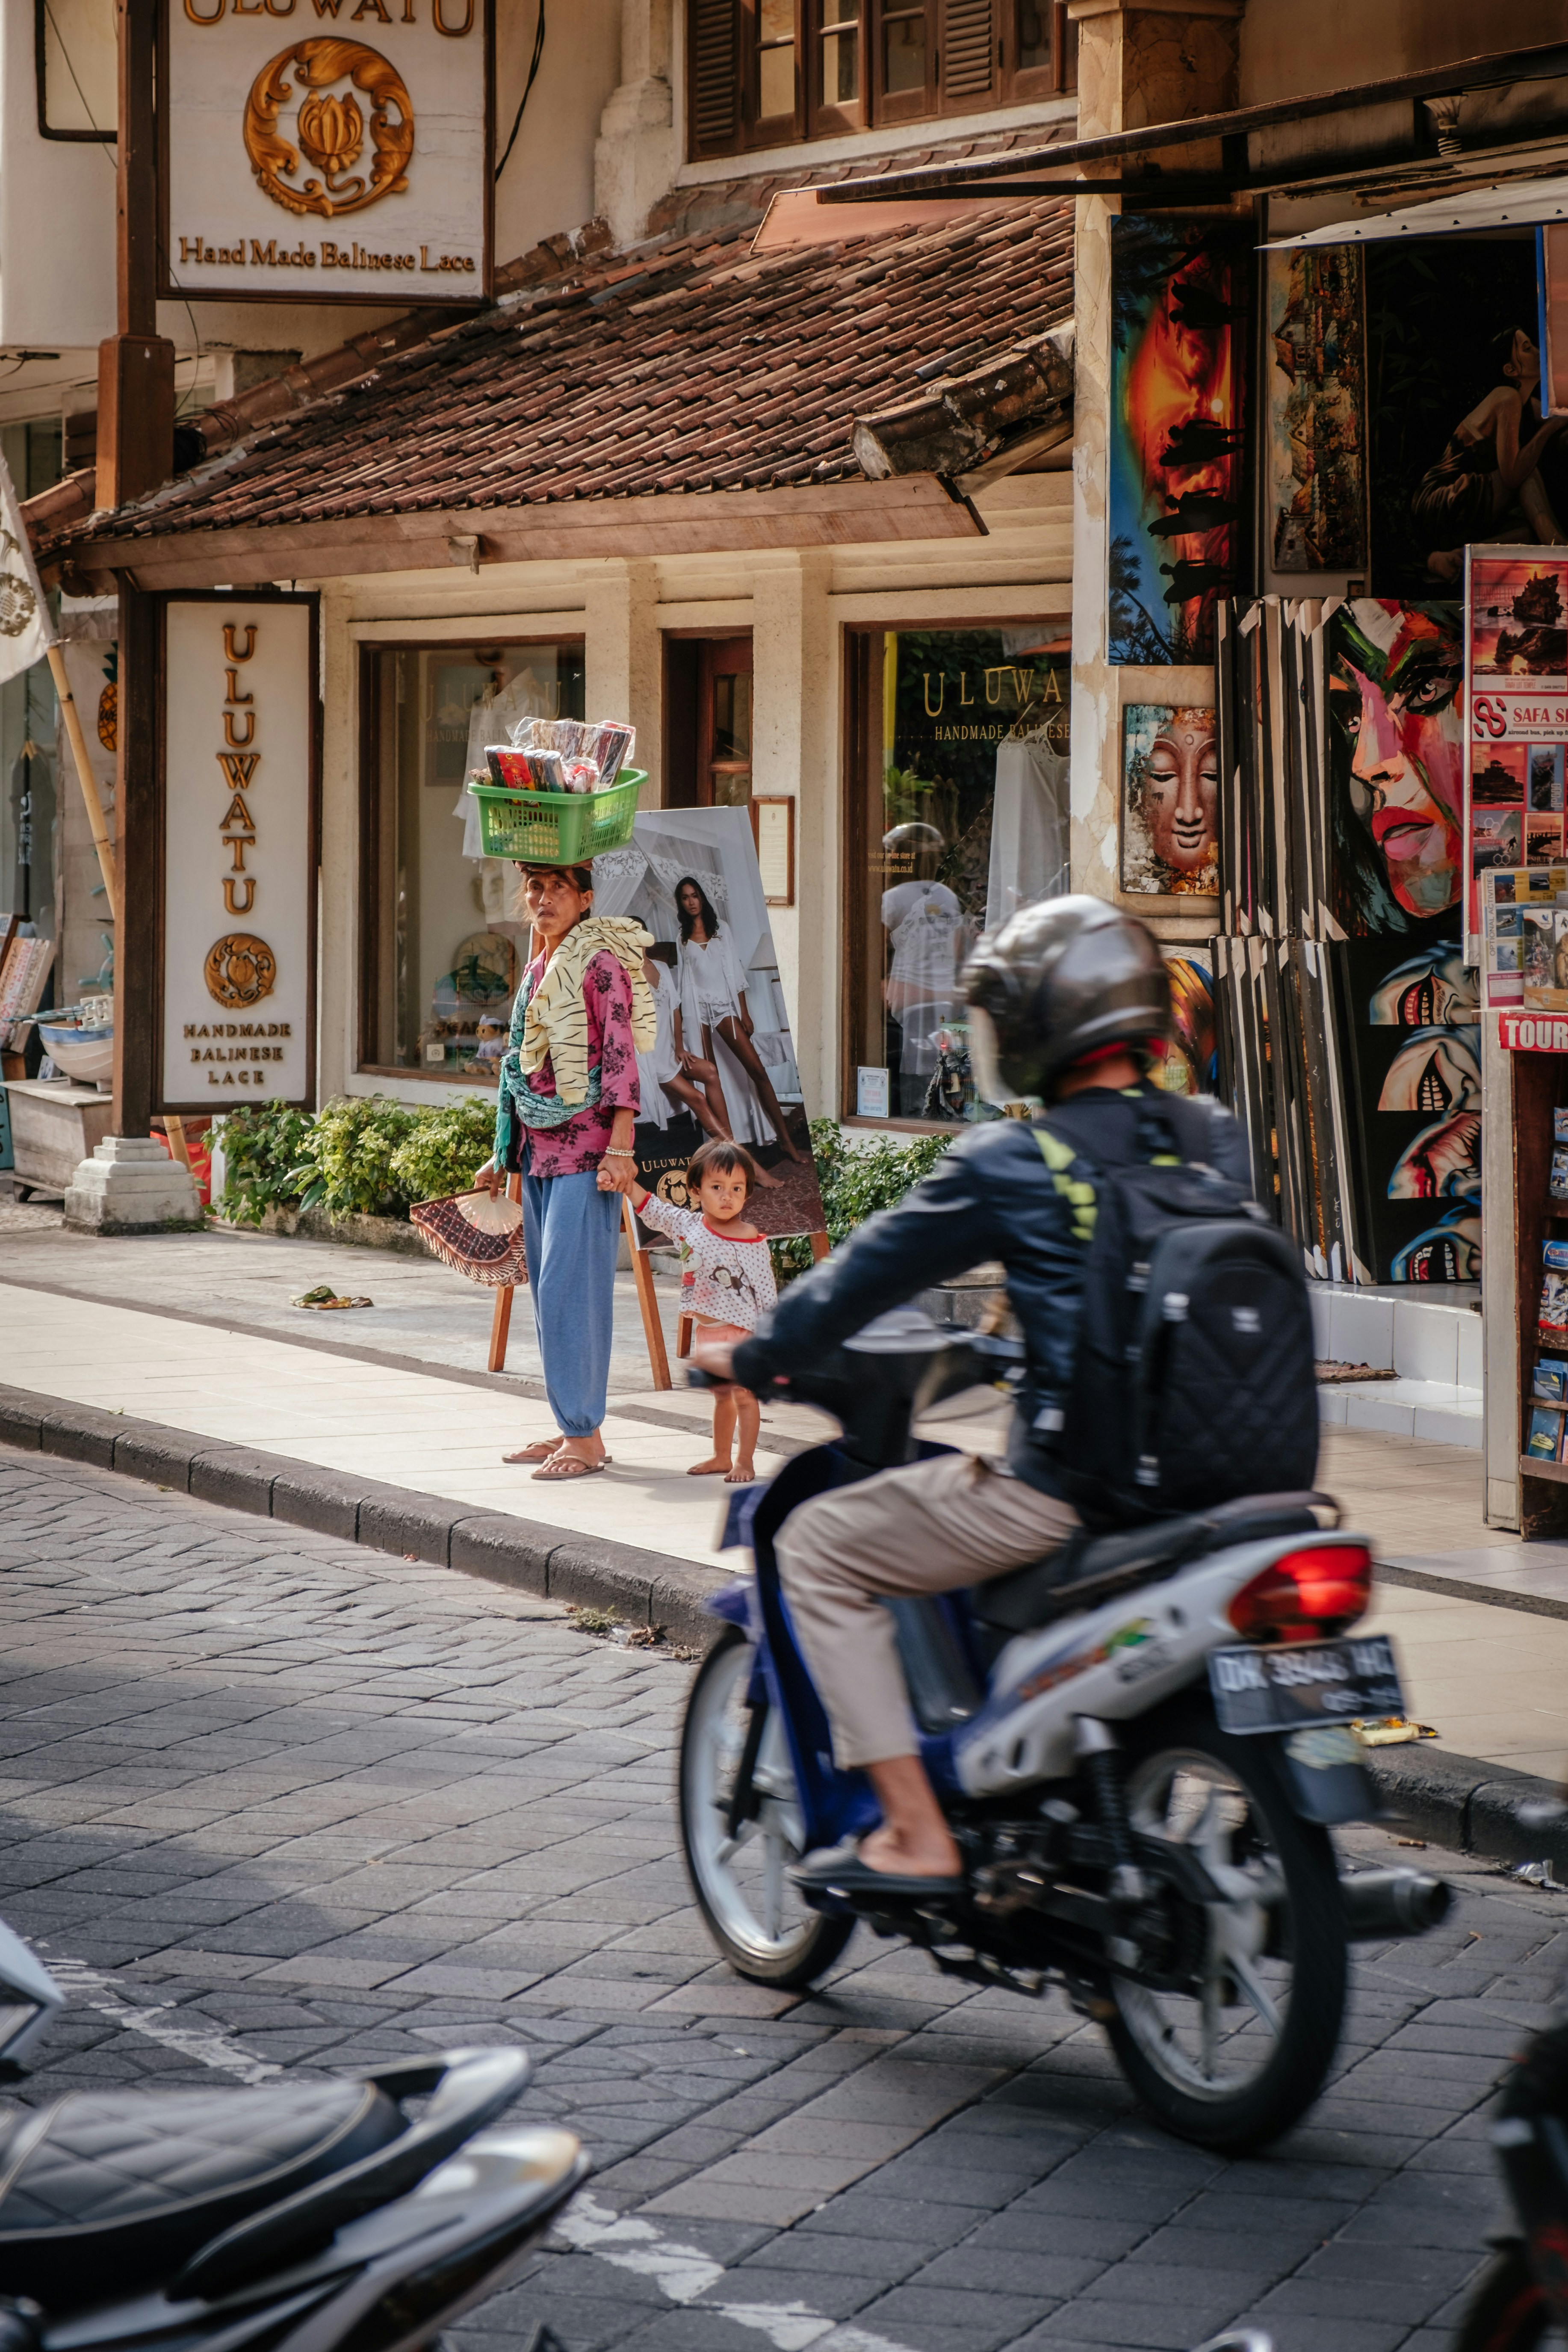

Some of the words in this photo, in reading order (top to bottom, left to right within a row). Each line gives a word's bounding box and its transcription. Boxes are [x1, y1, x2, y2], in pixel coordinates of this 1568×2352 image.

[179, 236, 245, 265] Hand
[250, 239, 316, 266] Made
[320, 241, 415, 269] Balinese
[419, 245, 475, 271] Lace
[1514, 708, 1550, 722] SAFA
[1556, 708, 1568, 723] S
[935, 725, 1004, 740] HANDMADE
[1010, 724, 1070, 739] BAESE
[216, 624, 261, 915] ULUWATU
[183, 1023, 292, 1038] HANDMADE
[1505, 1019, 1568, 1049] TOUR
[190, 1047, 283, 1061] BALINESE
[208, 1071, 264, 1084] LACE
